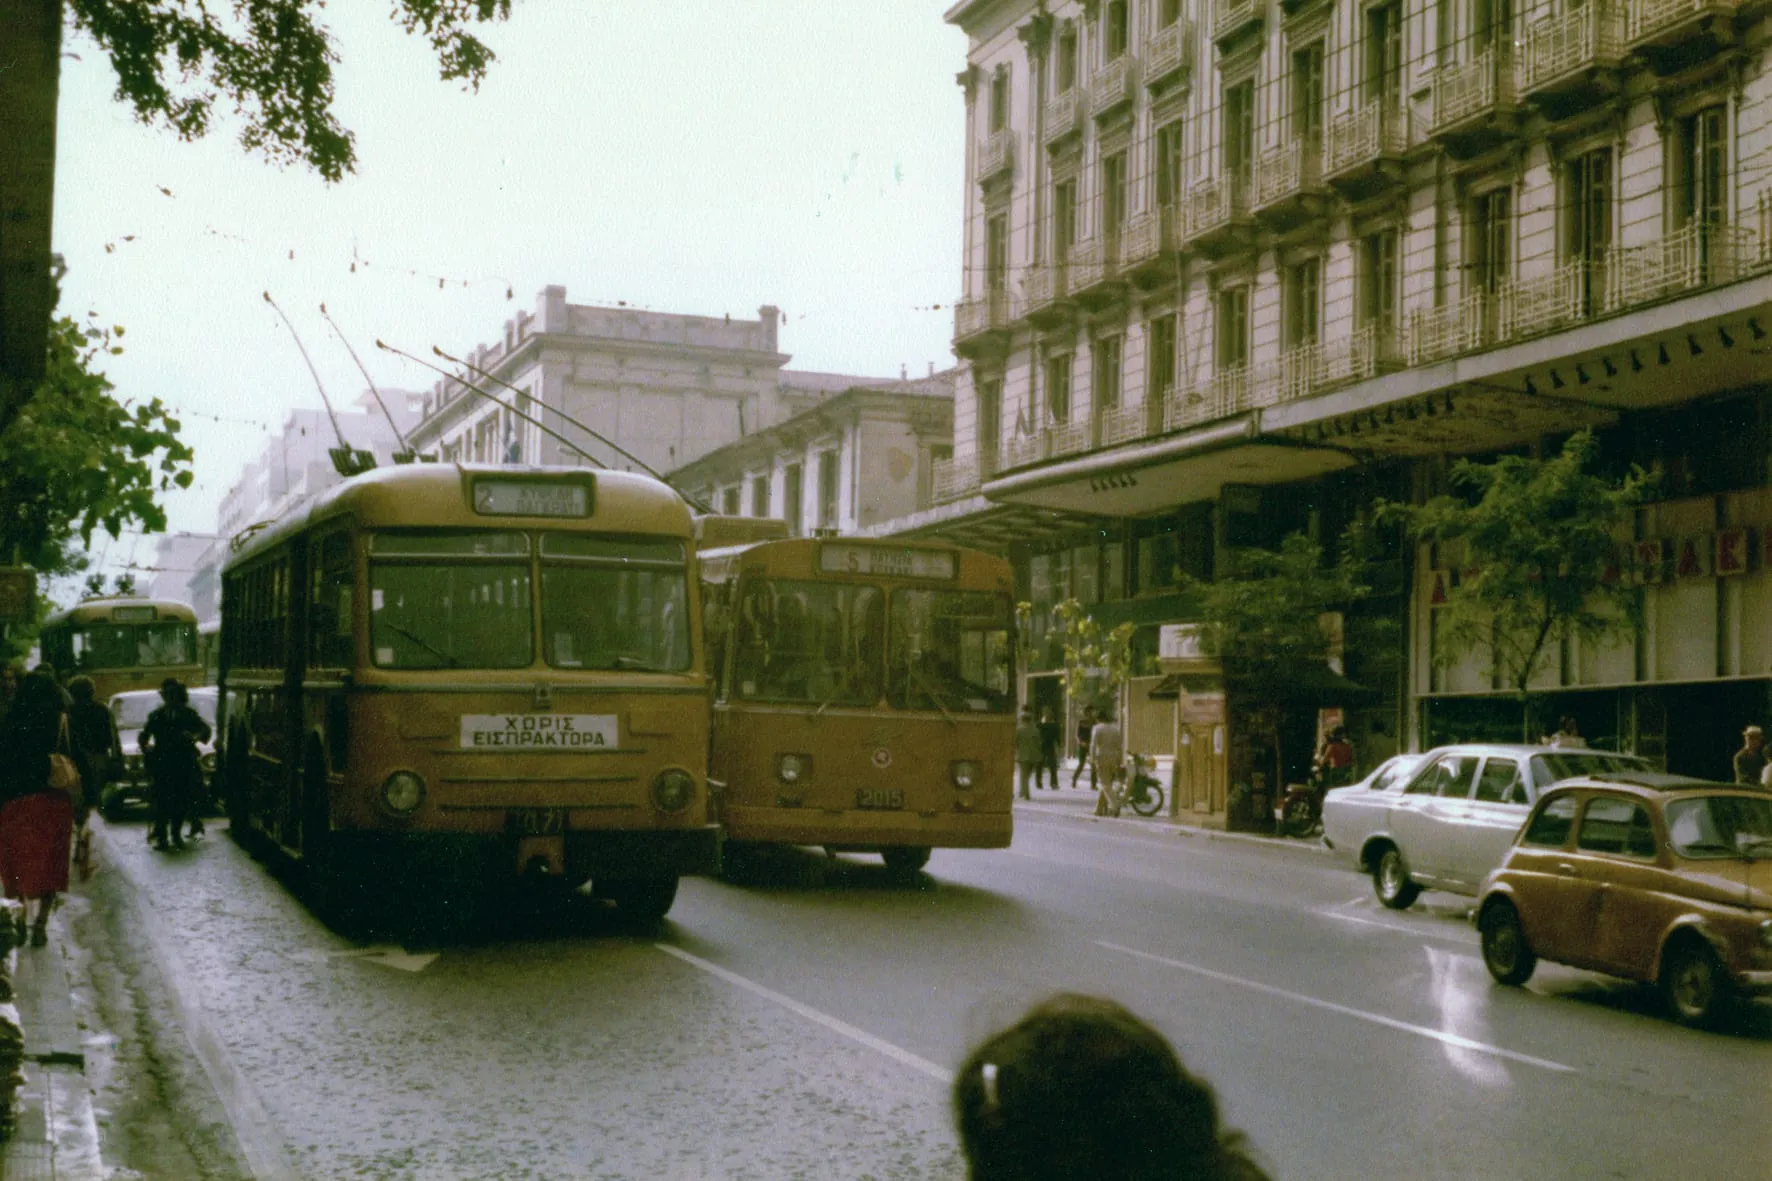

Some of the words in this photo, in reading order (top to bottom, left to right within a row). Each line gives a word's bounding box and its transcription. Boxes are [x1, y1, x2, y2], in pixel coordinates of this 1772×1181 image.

[477, 484, 494, 512] 2
[847, 551, 859, 571] 5
[473, 731, 605, 746] ΕΙΣΠΡΑΚΤΟΡΑ
[862, 788, 902, 807] 2015
